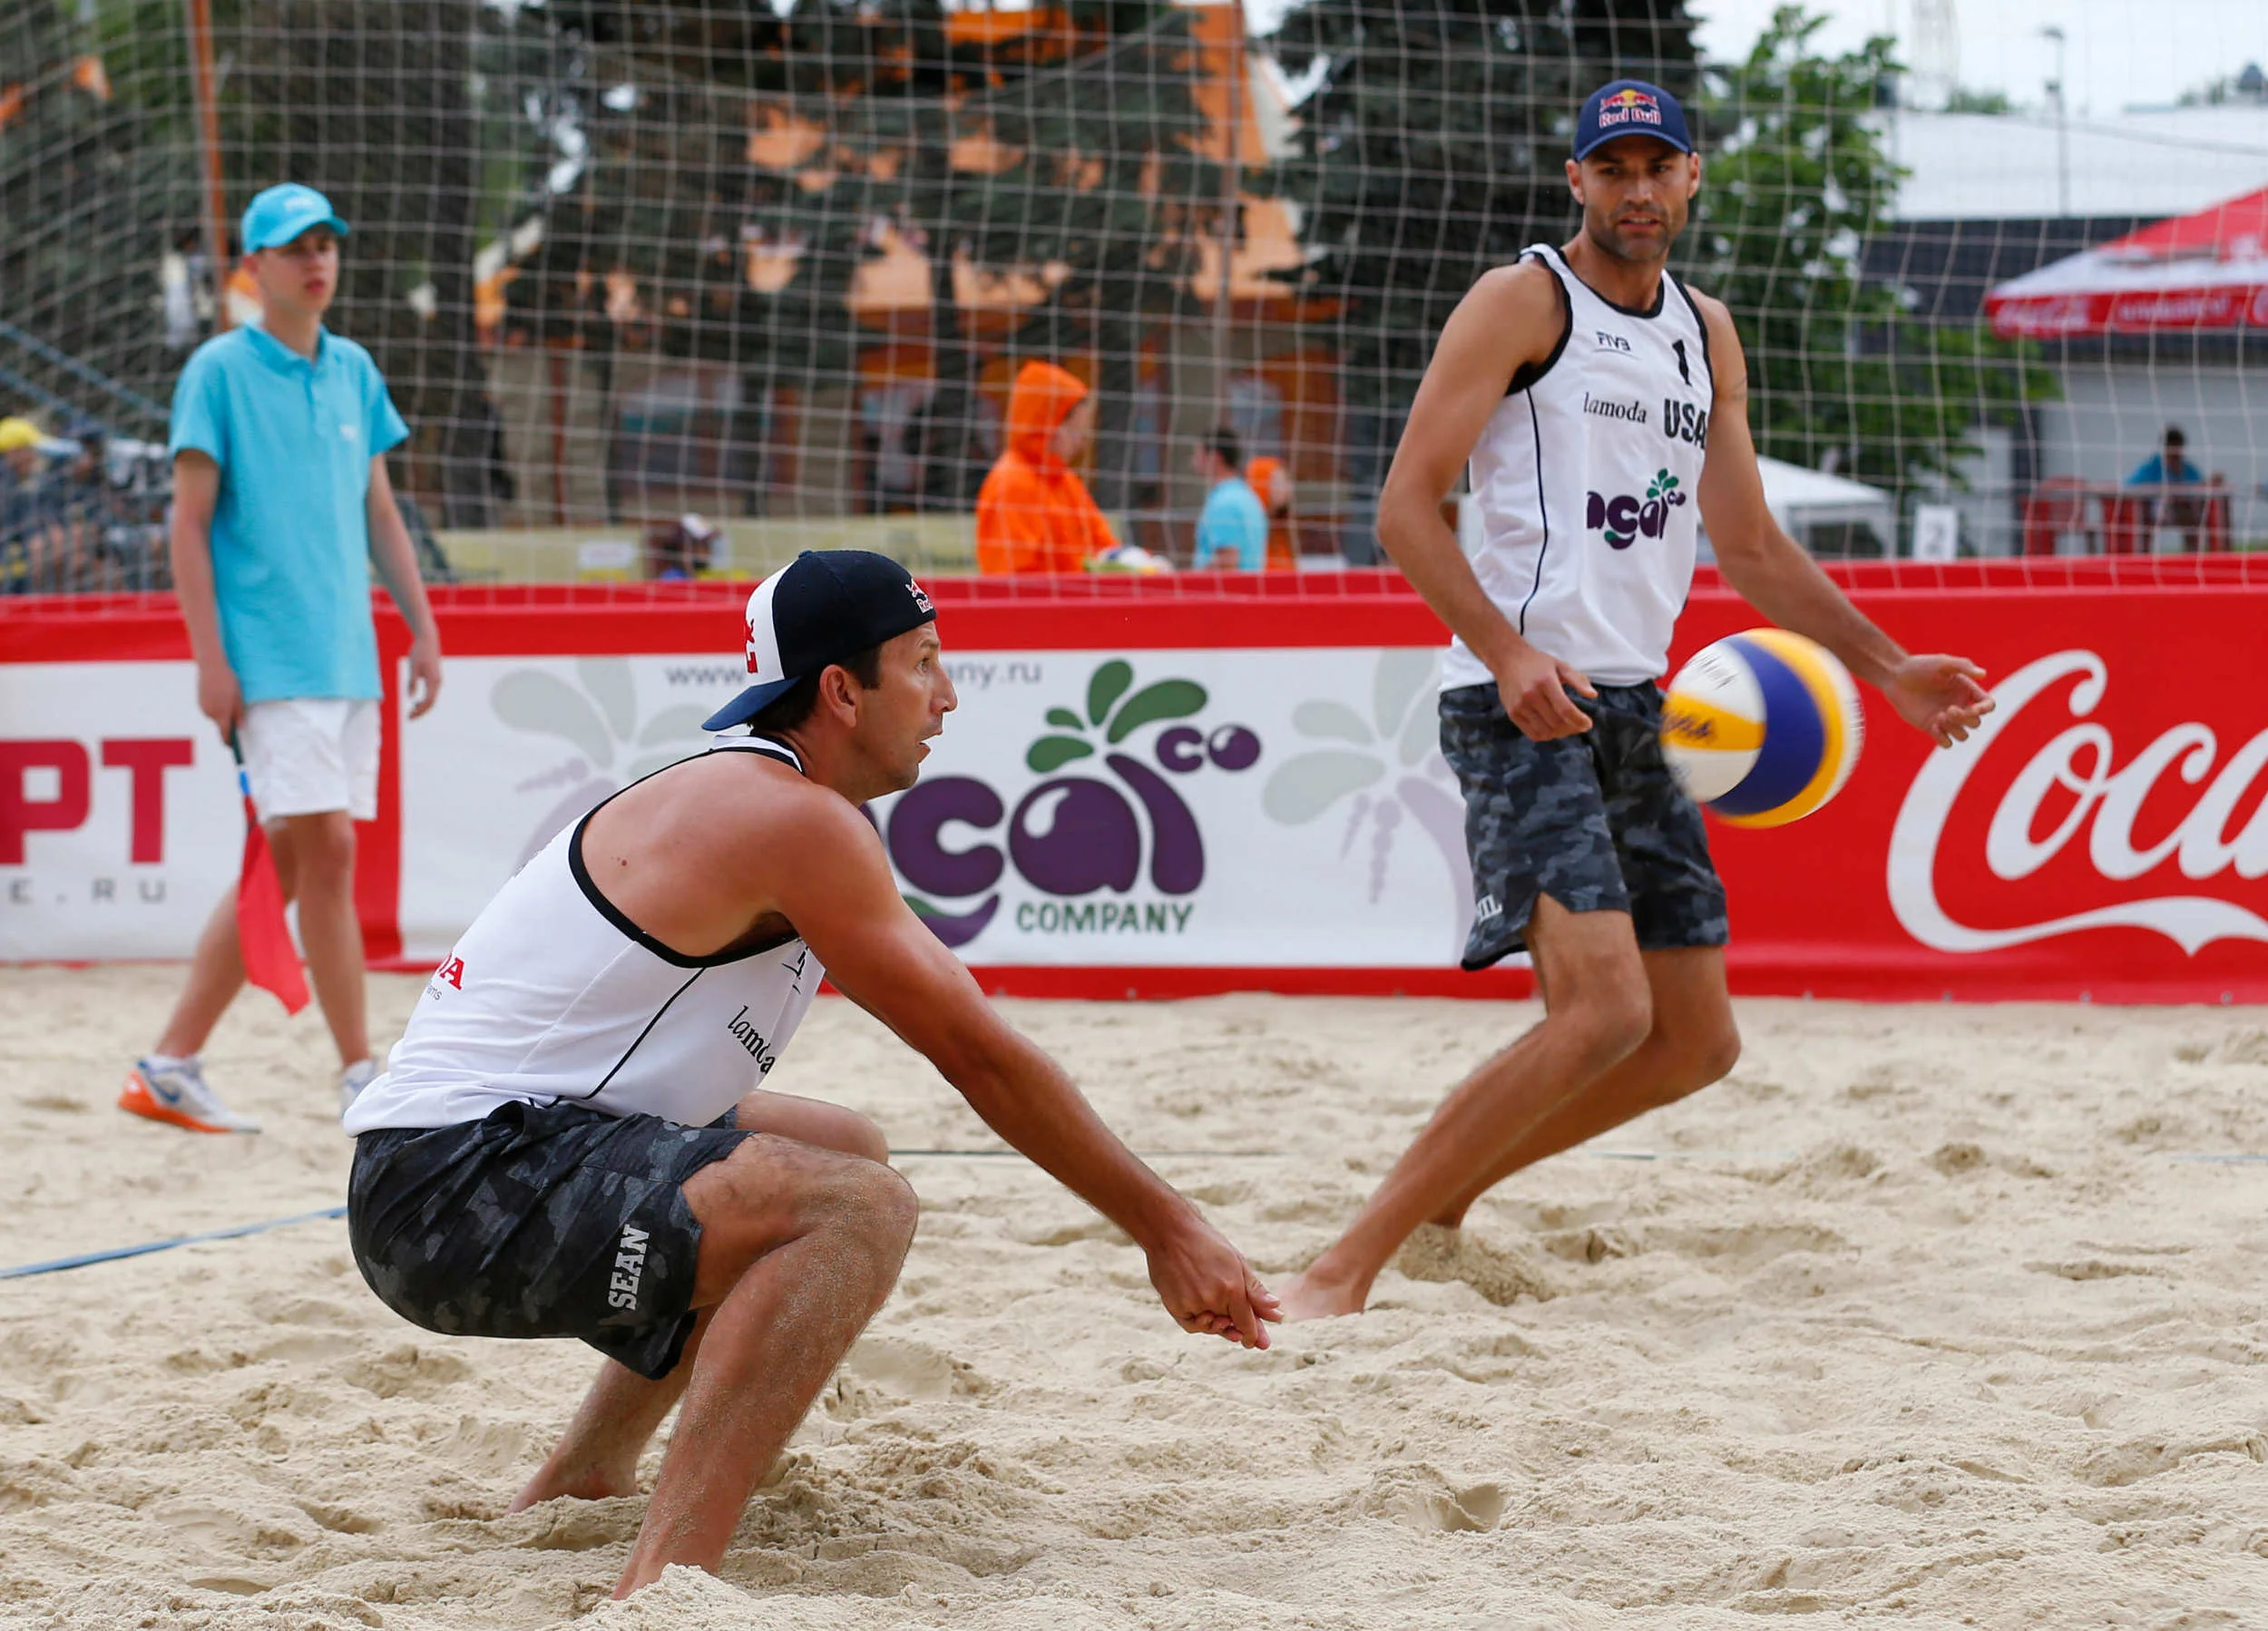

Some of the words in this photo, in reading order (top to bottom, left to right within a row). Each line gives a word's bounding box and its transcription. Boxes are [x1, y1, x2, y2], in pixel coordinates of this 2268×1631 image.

[1599, 107, 1629, 129] Red
[1631, 107, 1661, 126] Bull
[1583, 391, 1647, 425] lamoda
[1664, 397, 1708, 451] USA
[1886, 649, 2268, 953] Coca
[1016, 903, 1193, 933] COMPANY
[608, 1223, 650, 1312] SEAN
